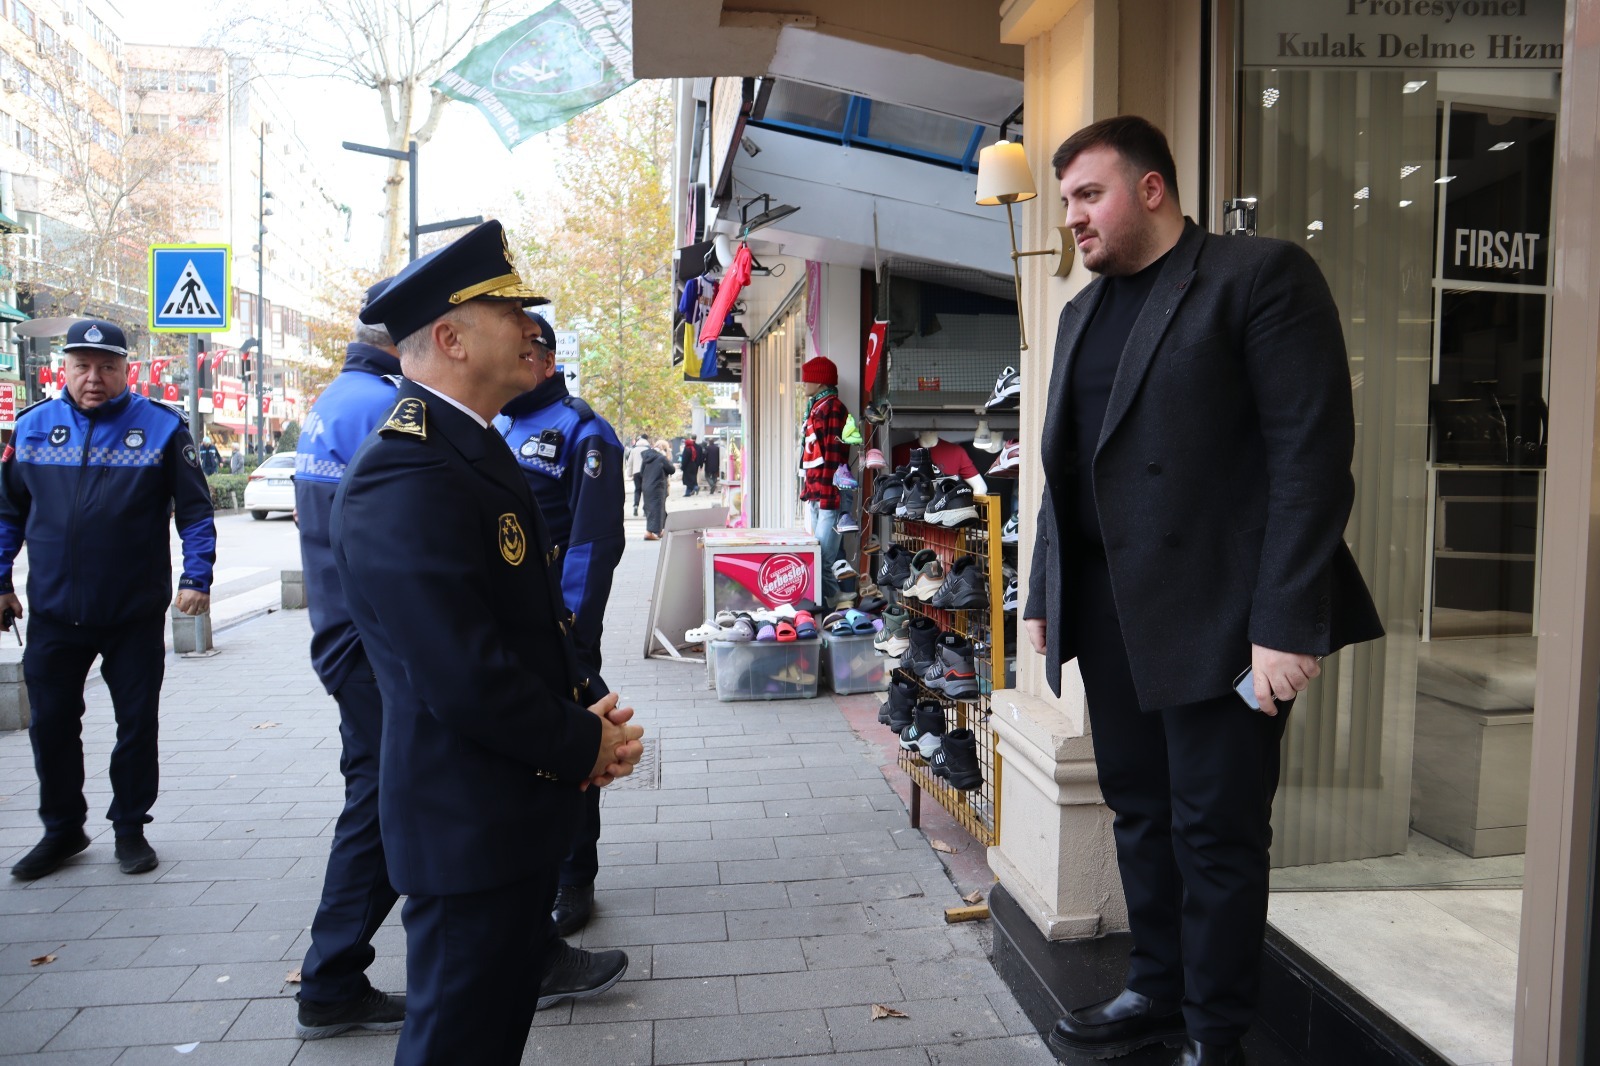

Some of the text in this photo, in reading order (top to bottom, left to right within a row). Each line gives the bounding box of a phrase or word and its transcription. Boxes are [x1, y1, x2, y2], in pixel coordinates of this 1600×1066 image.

[1346, 0, 1527, 23] Profesyonel
[1277, 33, 1366, 58] Kulak
[1378, 34, 1475, 59] Delme
[1455, 228, 1540, 270] FIRSAT
